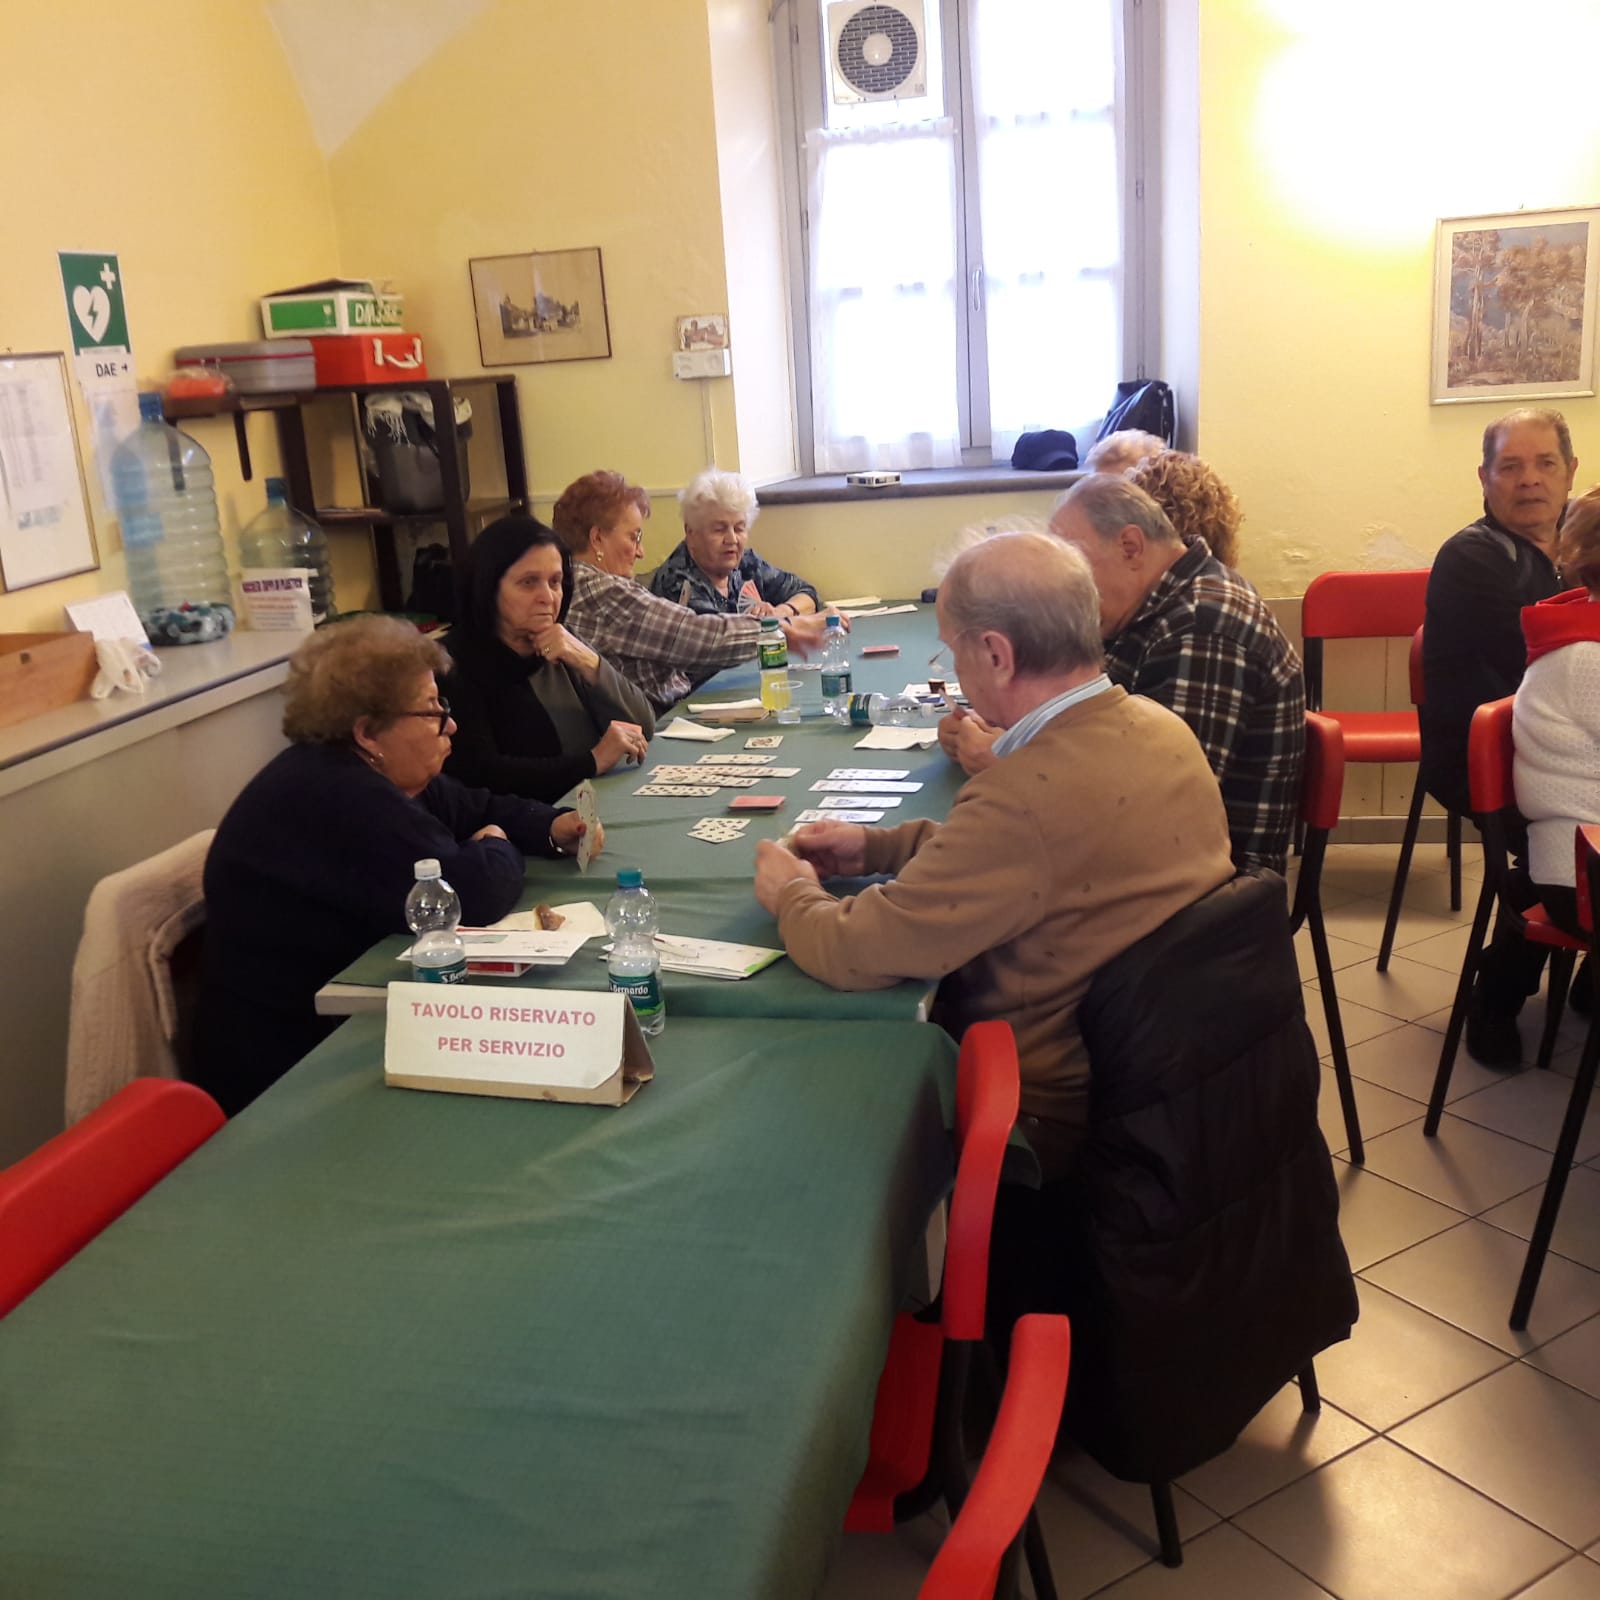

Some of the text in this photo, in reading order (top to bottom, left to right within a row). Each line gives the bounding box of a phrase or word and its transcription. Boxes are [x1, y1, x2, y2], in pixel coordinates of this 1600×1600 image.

[95, 362, 117, 378] DAE
[411, 1002, 596, 1026] TAVOLO RISERVATO
[438, 1036, 566, 1058] PER SERVIZIO
